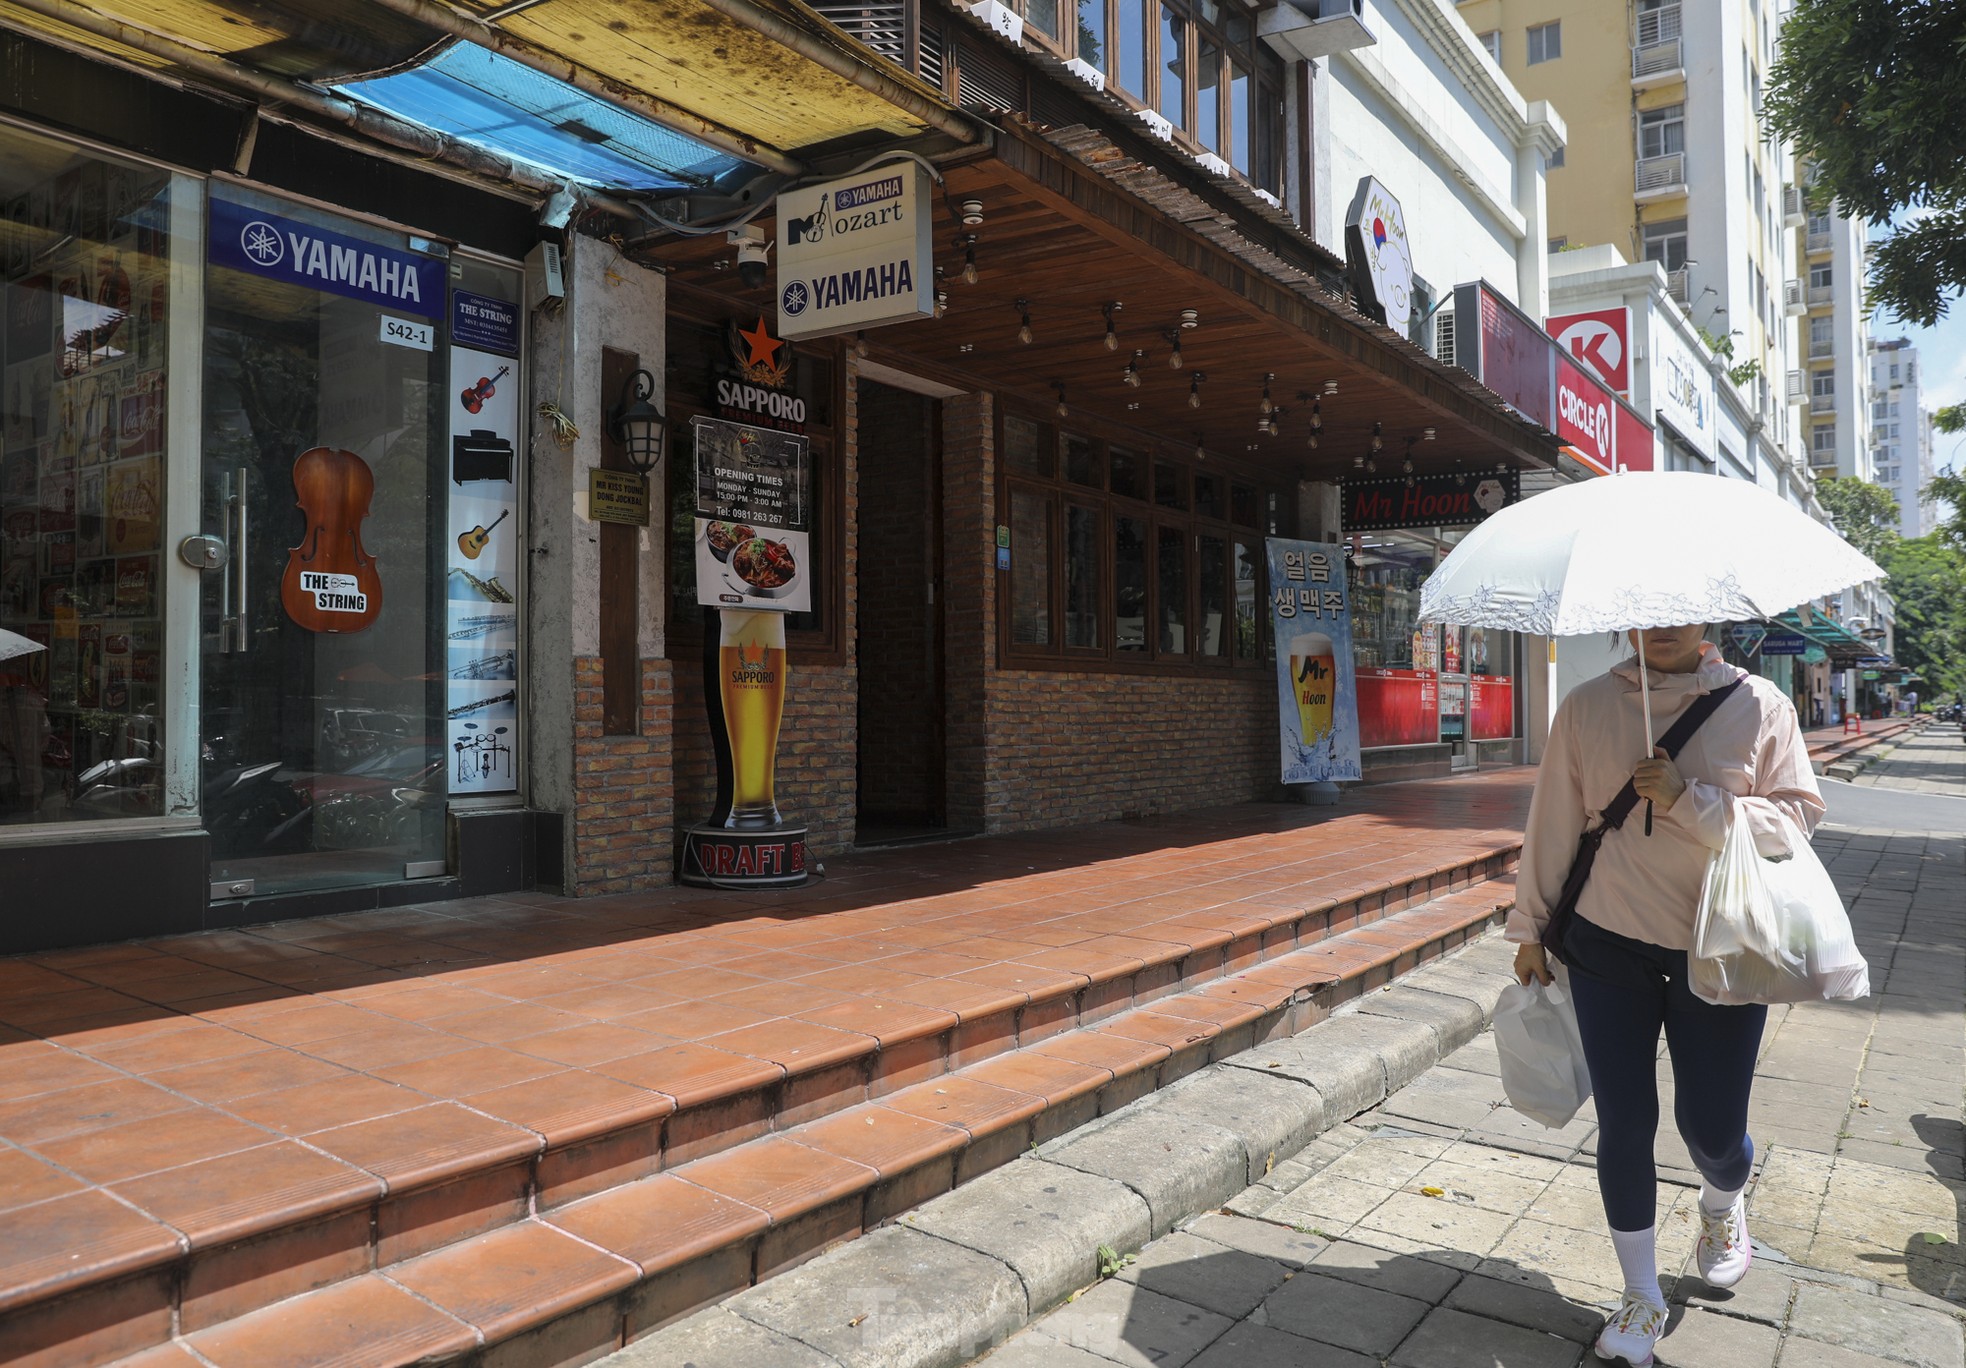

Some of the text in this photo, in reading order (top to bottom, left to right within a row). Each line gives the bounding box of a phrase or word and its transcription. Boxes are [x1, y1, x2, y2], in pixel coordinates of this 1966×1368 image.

[852, 179, 900, 205] YAMAHA
[288, 231, 421, 303] YAMAHA
[811, 259, 913, 310] YAMAHA
[459, 303, 512, 325] THE STRING
[386, 321, 428, 344] S42-1
[717, 379, 806, 423] SAPPORO
[1559, 384, 1595, 440] CIRCLE
[720, 407, 774, 428] PREMIUM
[714, 467, 783, 487] OPENING TIMES
[716, 491, 737, 501] 15:00
[737, 494, 748, 503] PM
[754, 497, 769, 506] 3:00
[771, 500, 782, 508] AM
[717, 482, 747, 493] MONDAY
[753, 487, 781, 498] SUNDAY
[1353, 485, 1471, 521] Mr Hoon
[716, 506, 783, 524] Tel: 0981 263 267
[1284, 551, 1330, 582] 얼음
[304, 574, 329, 590] THE
[318, 593, 364, 610] STRING
[1274, 587, 1344, 620] 생맥주
[731, 671, 775, 684] SAPPORO
[1298, 655, 1328, 684] Mr
[1302, 690, 1326, 705] Hoon
[701, 843, 786, 876] DRAFT
